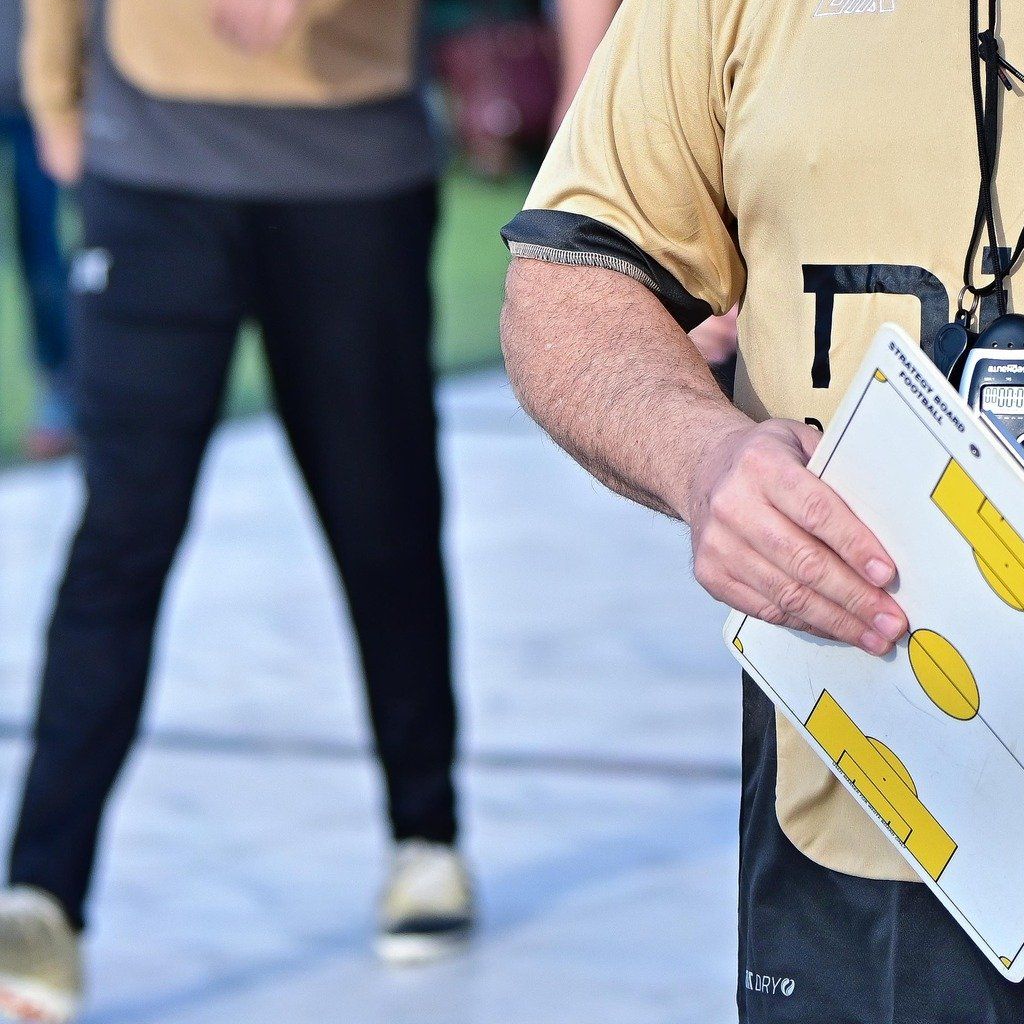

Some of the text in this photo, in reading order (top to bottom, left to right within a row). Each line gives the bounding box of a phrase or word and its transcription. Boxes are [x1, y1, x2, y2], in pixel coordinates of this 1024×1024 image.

[889, 342, 965, 433] STRATEGY BOARD
[899, 371, 943, 425] FOOTBALL
[755, 974, 781, 994] DRY
